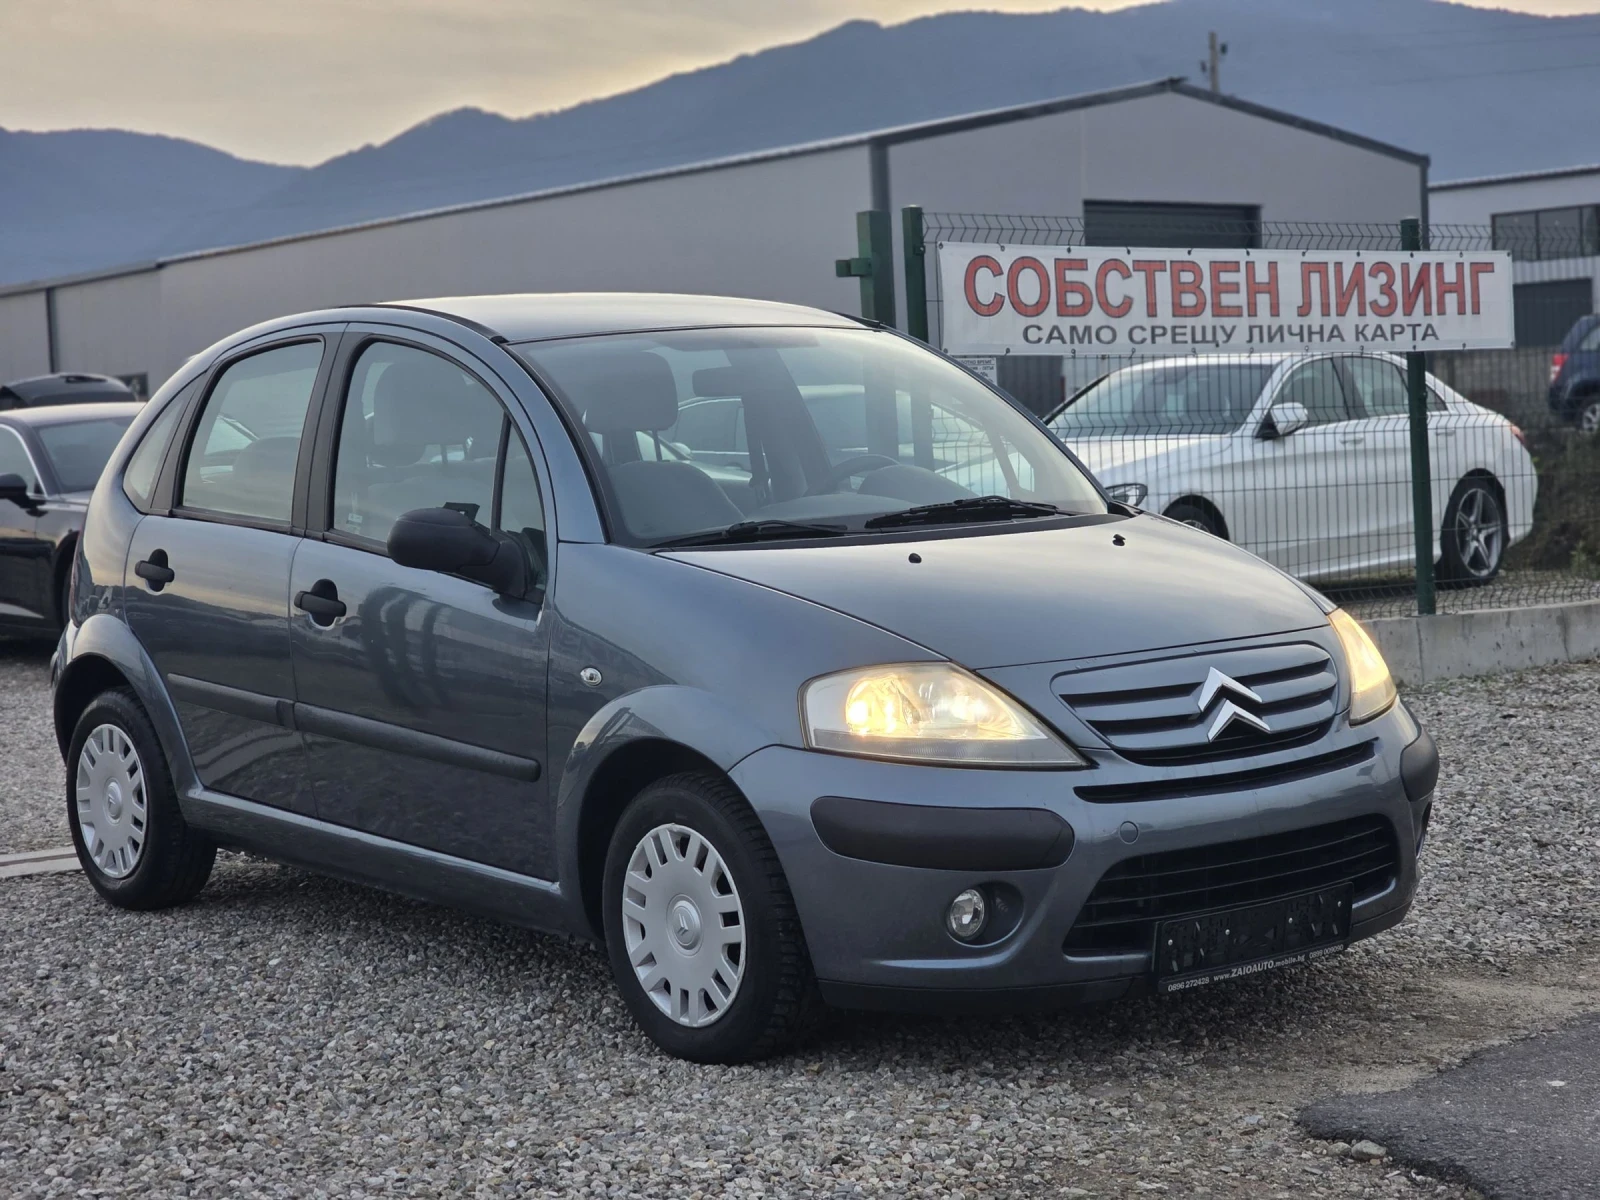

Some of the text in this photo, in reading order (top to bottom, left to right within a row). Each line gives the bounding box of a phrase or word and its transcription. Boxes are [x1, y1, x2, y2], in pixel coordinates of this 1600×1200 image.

[964, 255, 1495, 318] СОБСТВЕН ЛИЗИНГ
[1022, 323, 1439, 346] САМО СРЕЩУ ЛИЧНА КАРТА
[1167, 981, 1185, 992] 0896
